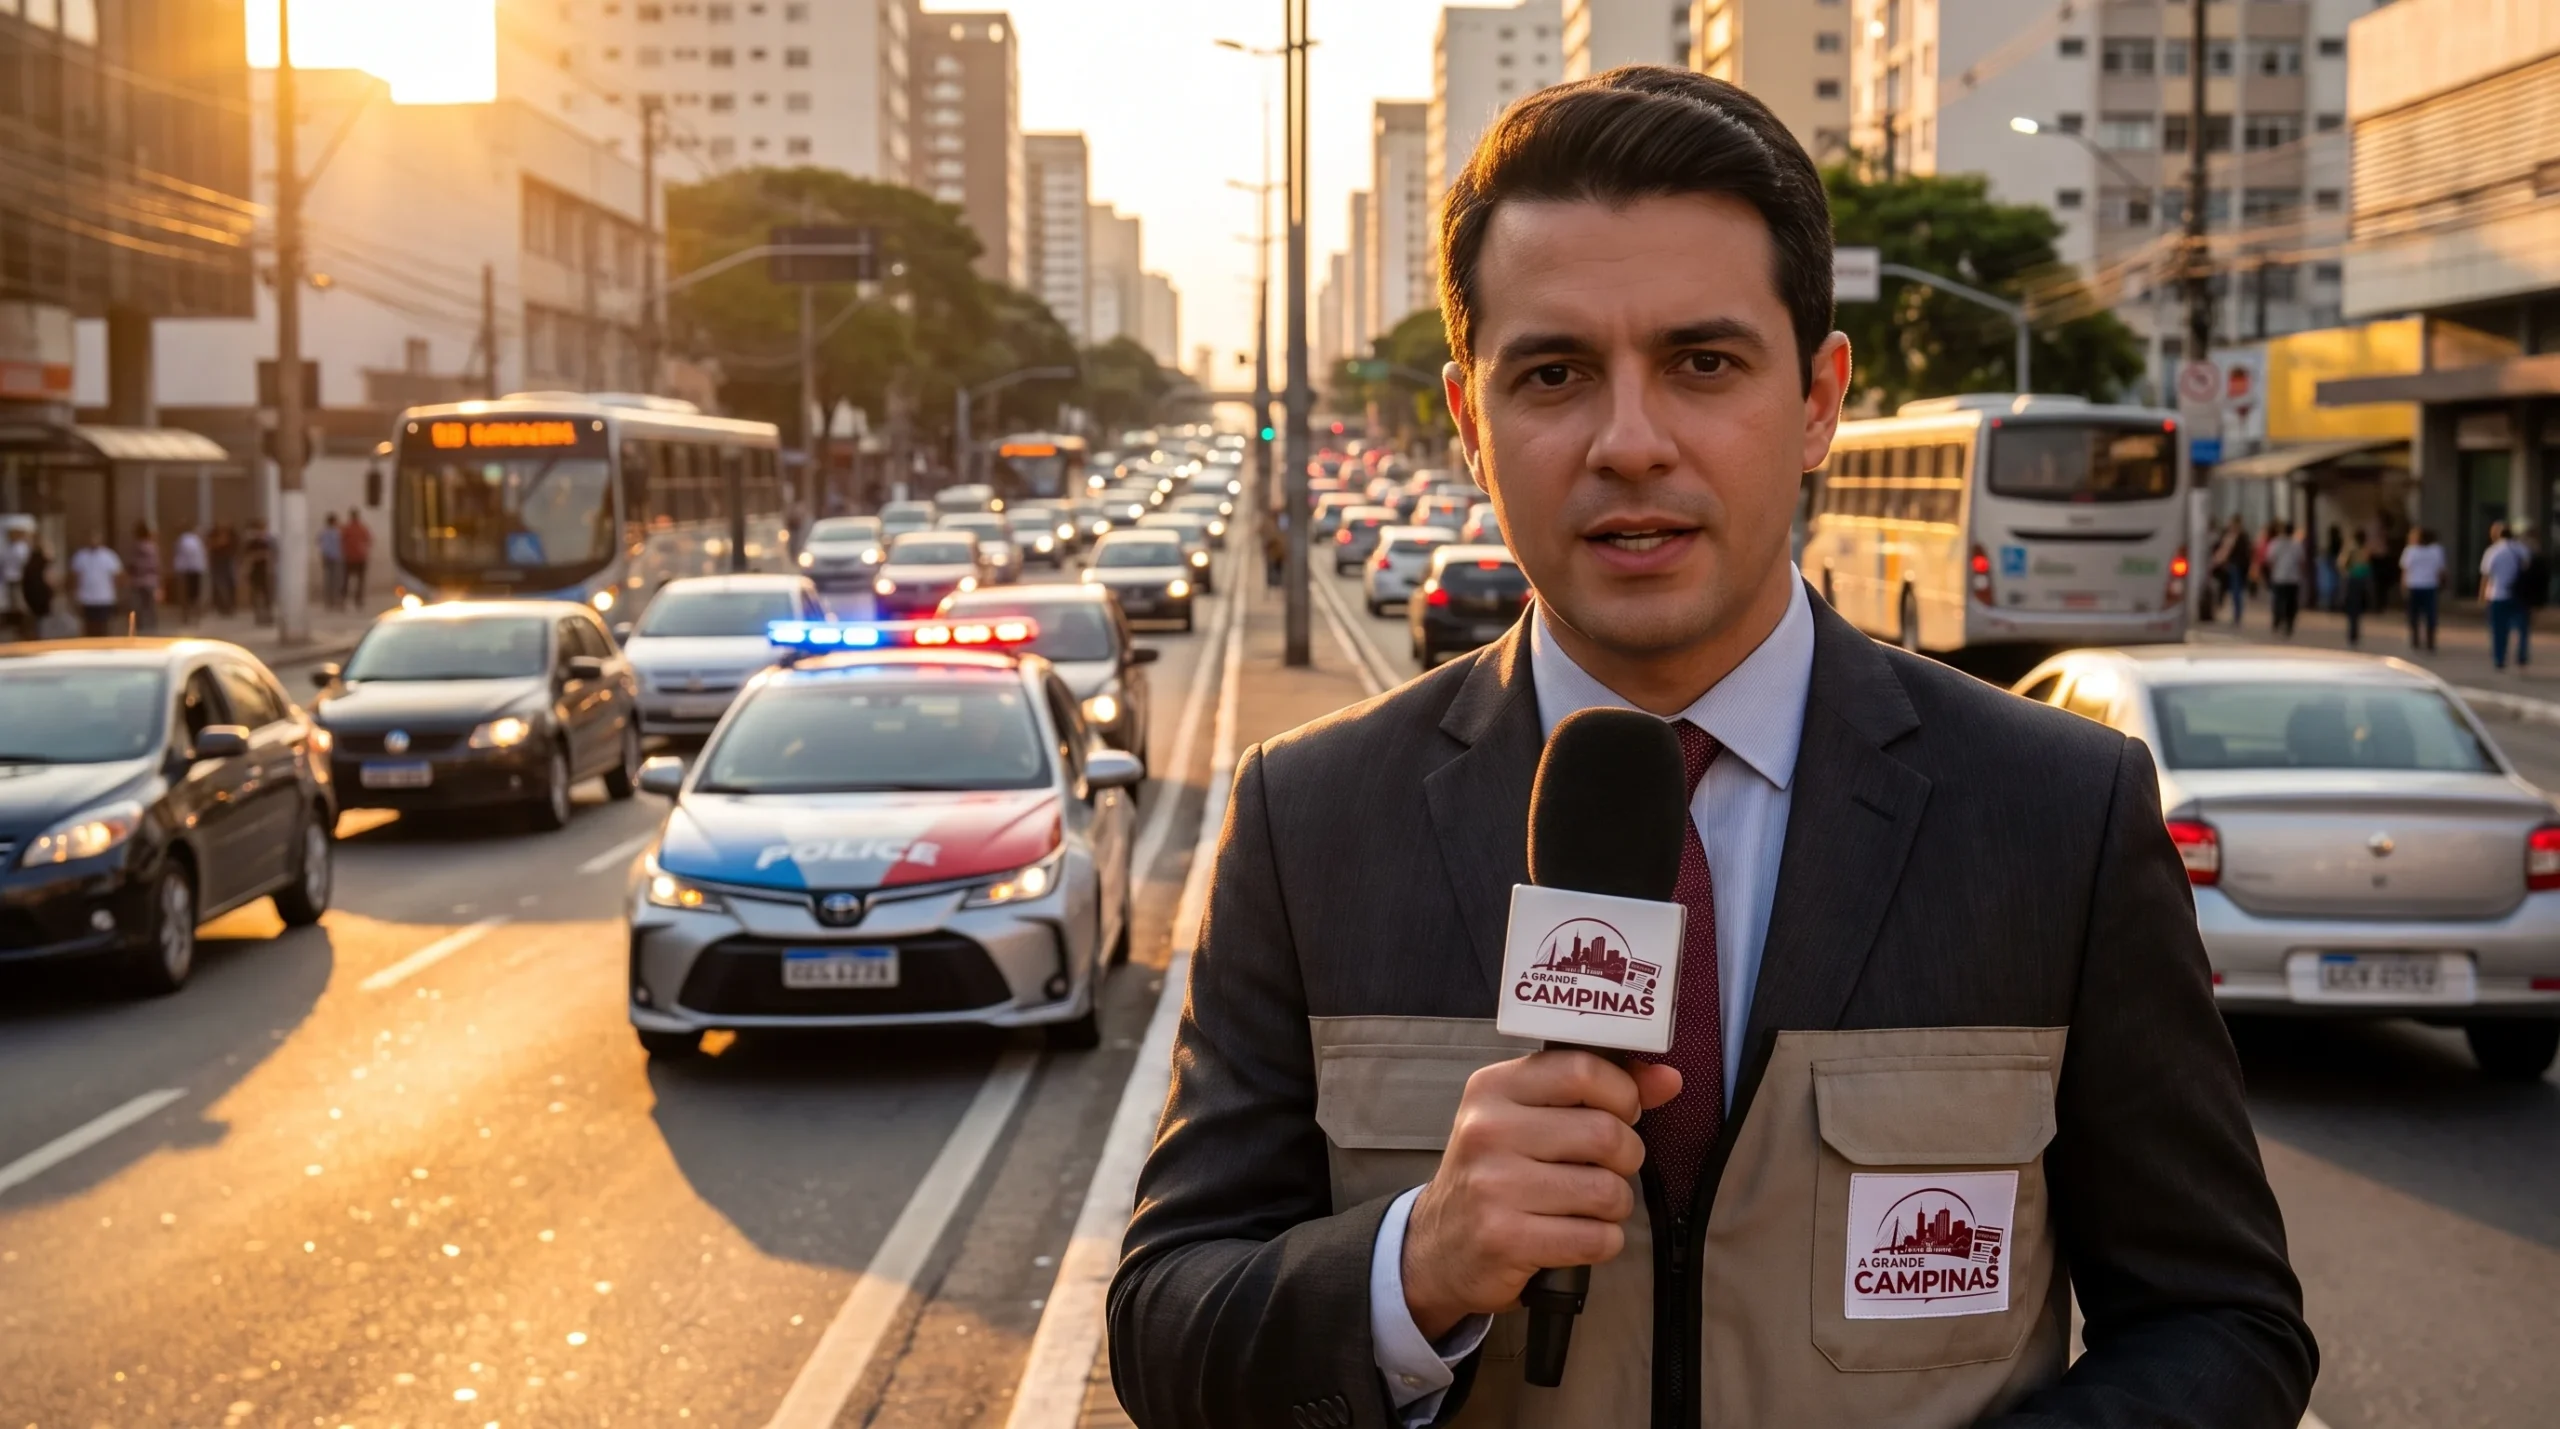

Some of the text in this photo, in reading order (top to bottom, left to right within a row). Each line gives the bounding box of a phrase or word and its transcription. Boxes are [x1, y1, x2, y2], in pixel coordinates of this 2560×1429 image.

[755, 838, 942, 870] POLICE
[1520, 971, 1578, 985] A GRANDE
[1514, 981, 1655, 1016] CAMPINAS
[1858, 1257, 1925, 1268] A GRANDE
[1854, 1265, 1999, 1294] CAMPINAS
